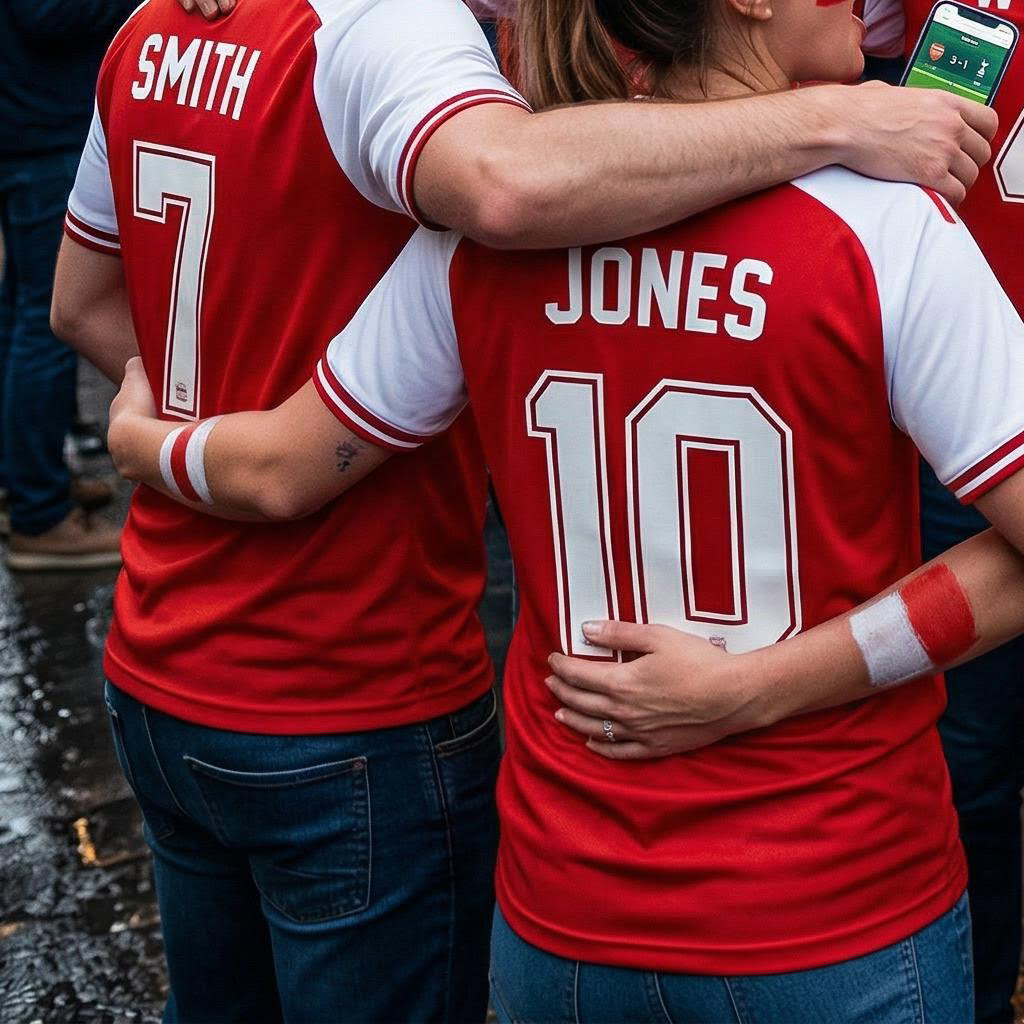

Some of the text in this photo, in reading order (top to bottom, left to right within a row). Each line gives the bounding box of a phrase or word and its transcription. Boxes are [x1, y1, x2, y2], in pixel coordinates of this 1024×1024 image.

[131, 33, 262, 121] SMITH
[132, 139, 217, 422] 7
[544, 246, 774, 342] JONES
[525, 369, 803, 664] 10
